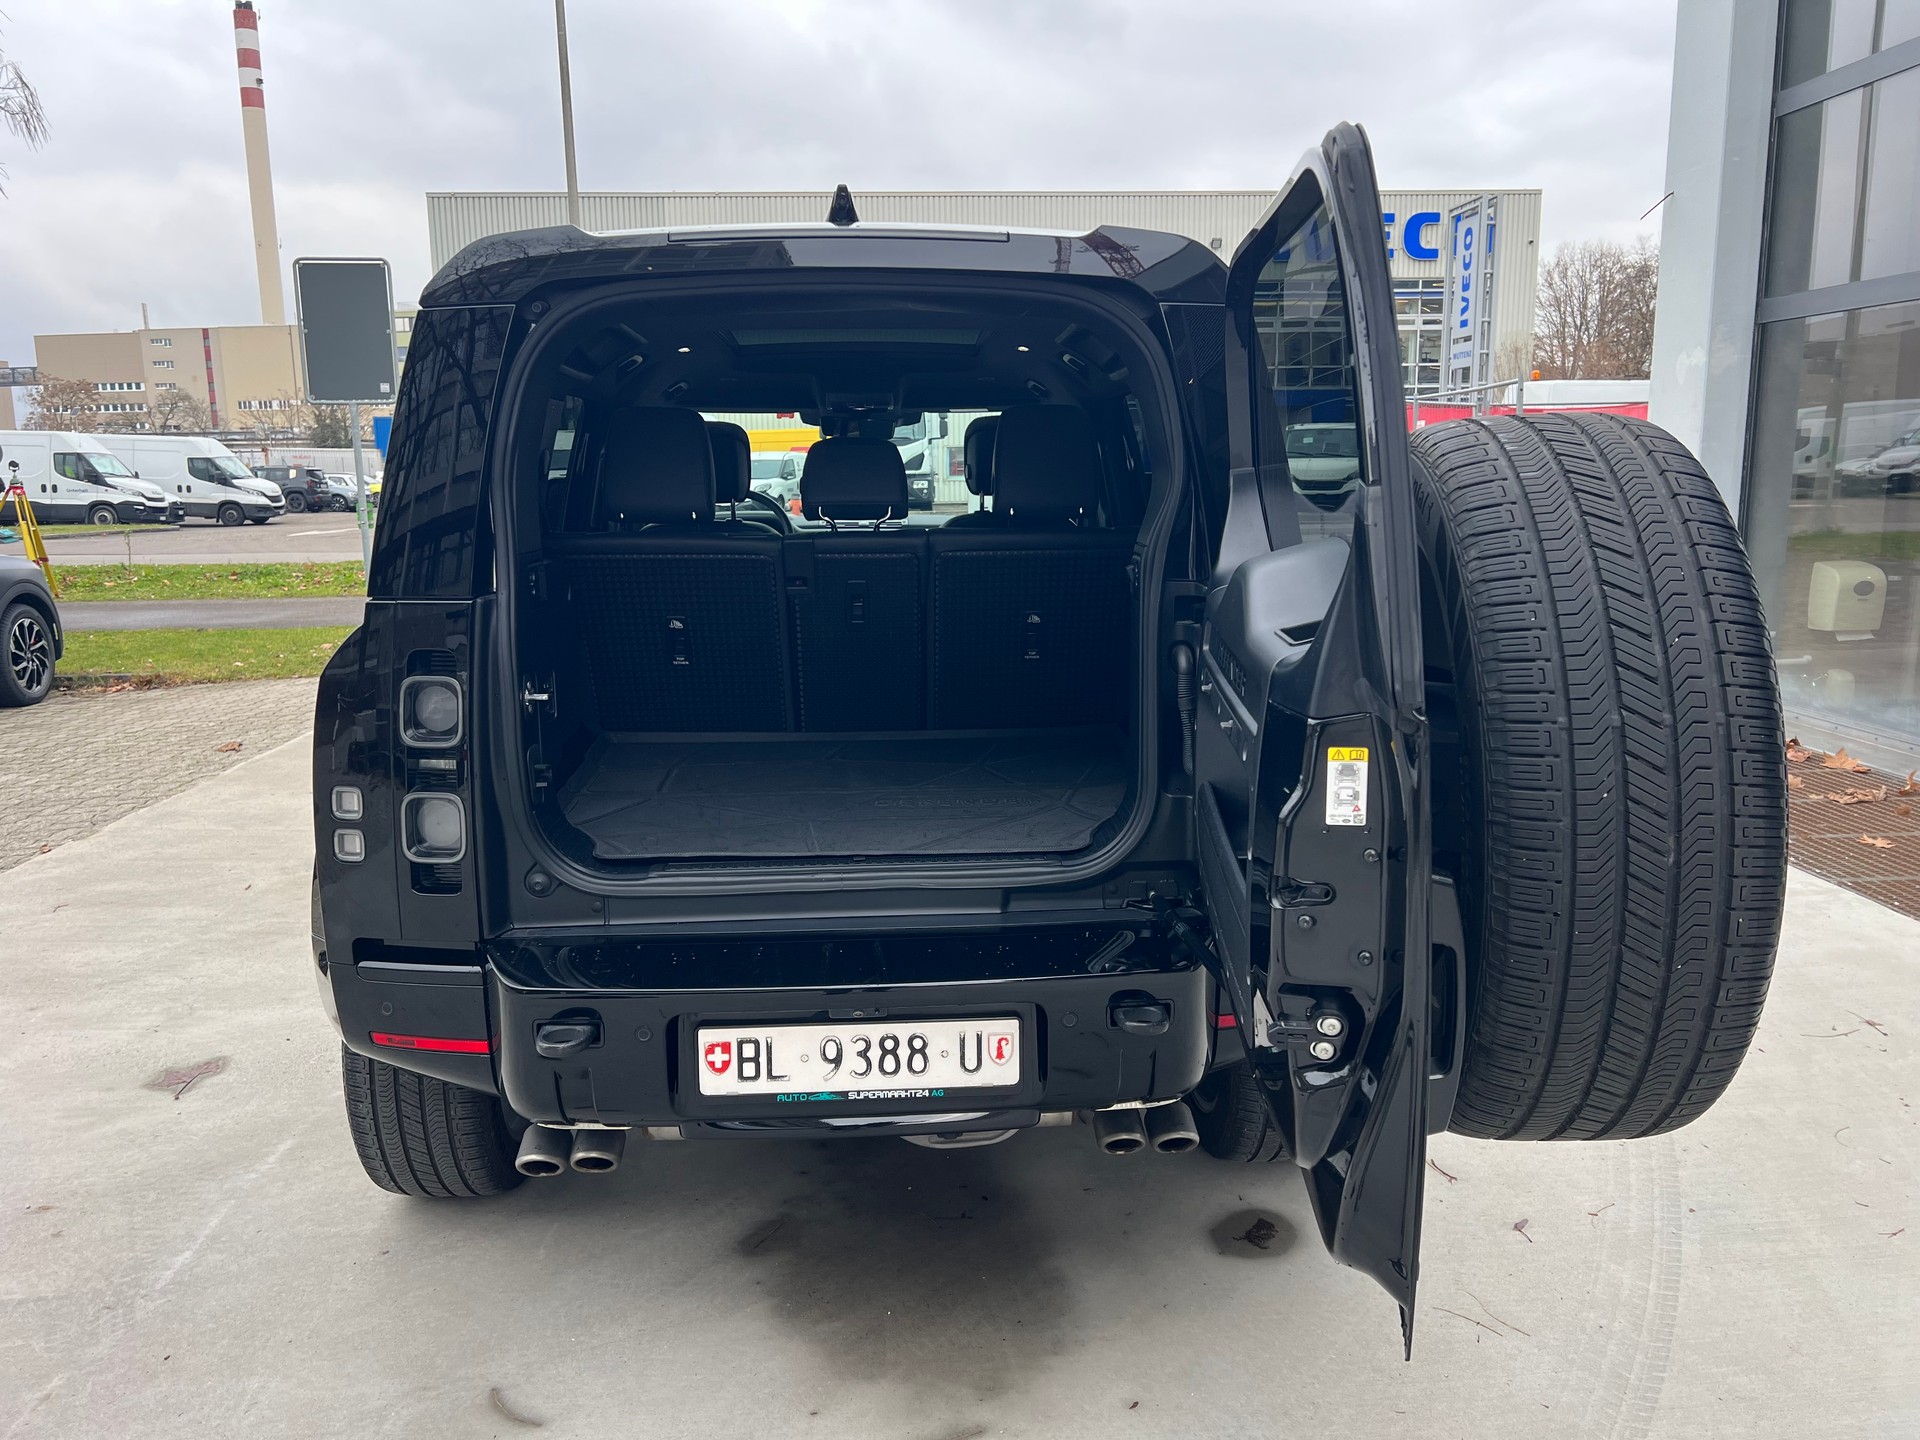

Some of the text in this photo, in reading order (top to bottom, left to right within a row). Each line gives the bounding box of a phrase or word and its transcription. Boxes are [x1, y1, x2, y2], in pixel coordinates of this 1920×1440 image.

[1459, 226, 1474, 328] IVECO
[1453, 350, 1472, 360] MUTTENZ
[736, 1030, 983, 1082] BL 9388 U
[777, 1093, 808, 1102] AUTO
[931, 1089, 944, 1097] AG
